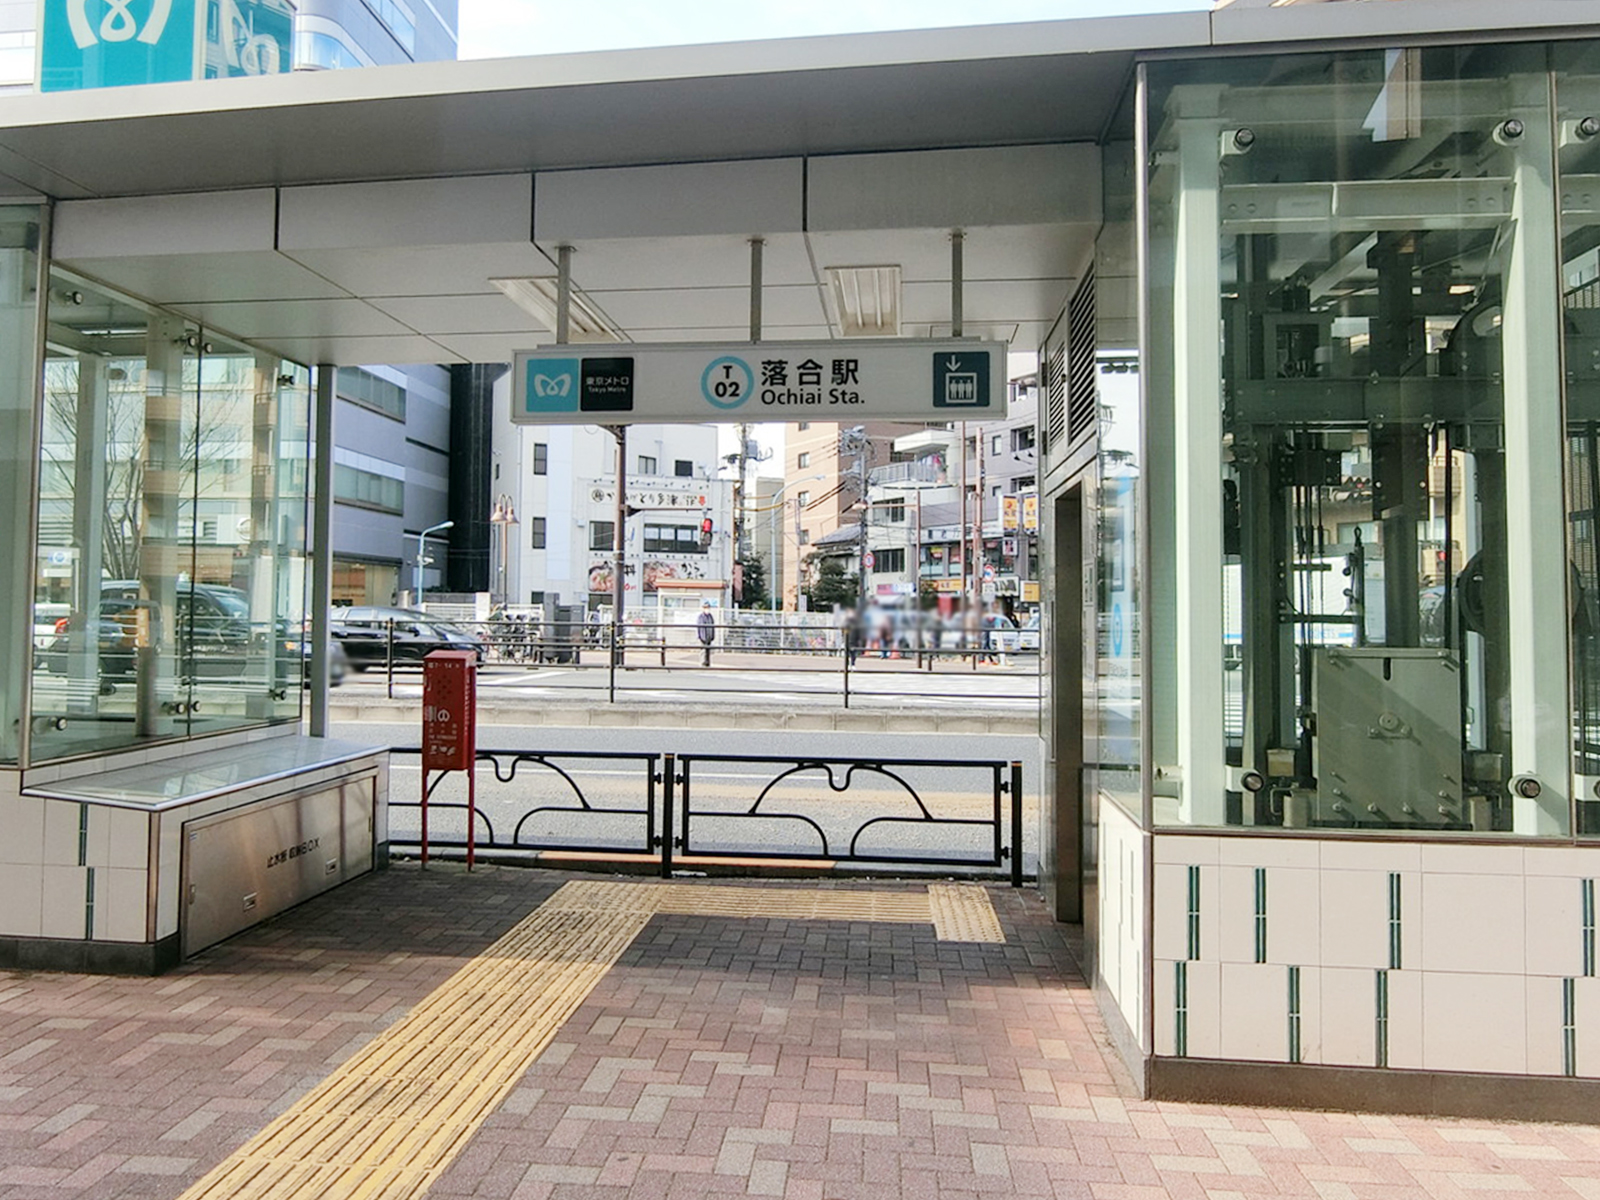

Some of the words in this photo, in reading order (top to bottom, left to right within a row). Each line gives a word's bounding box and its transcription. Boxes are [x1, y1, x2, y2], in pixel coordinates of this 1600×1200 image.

[723, 365, 733, 379] T
[761, 359, 859, 386] 落合駅
[586, 376, 630, 386] 東京メトロ
[715, 382, 740, 398] 02
[761, 388, 822, 405] Ochiai
[829, 388, 865, 405] Sta.
